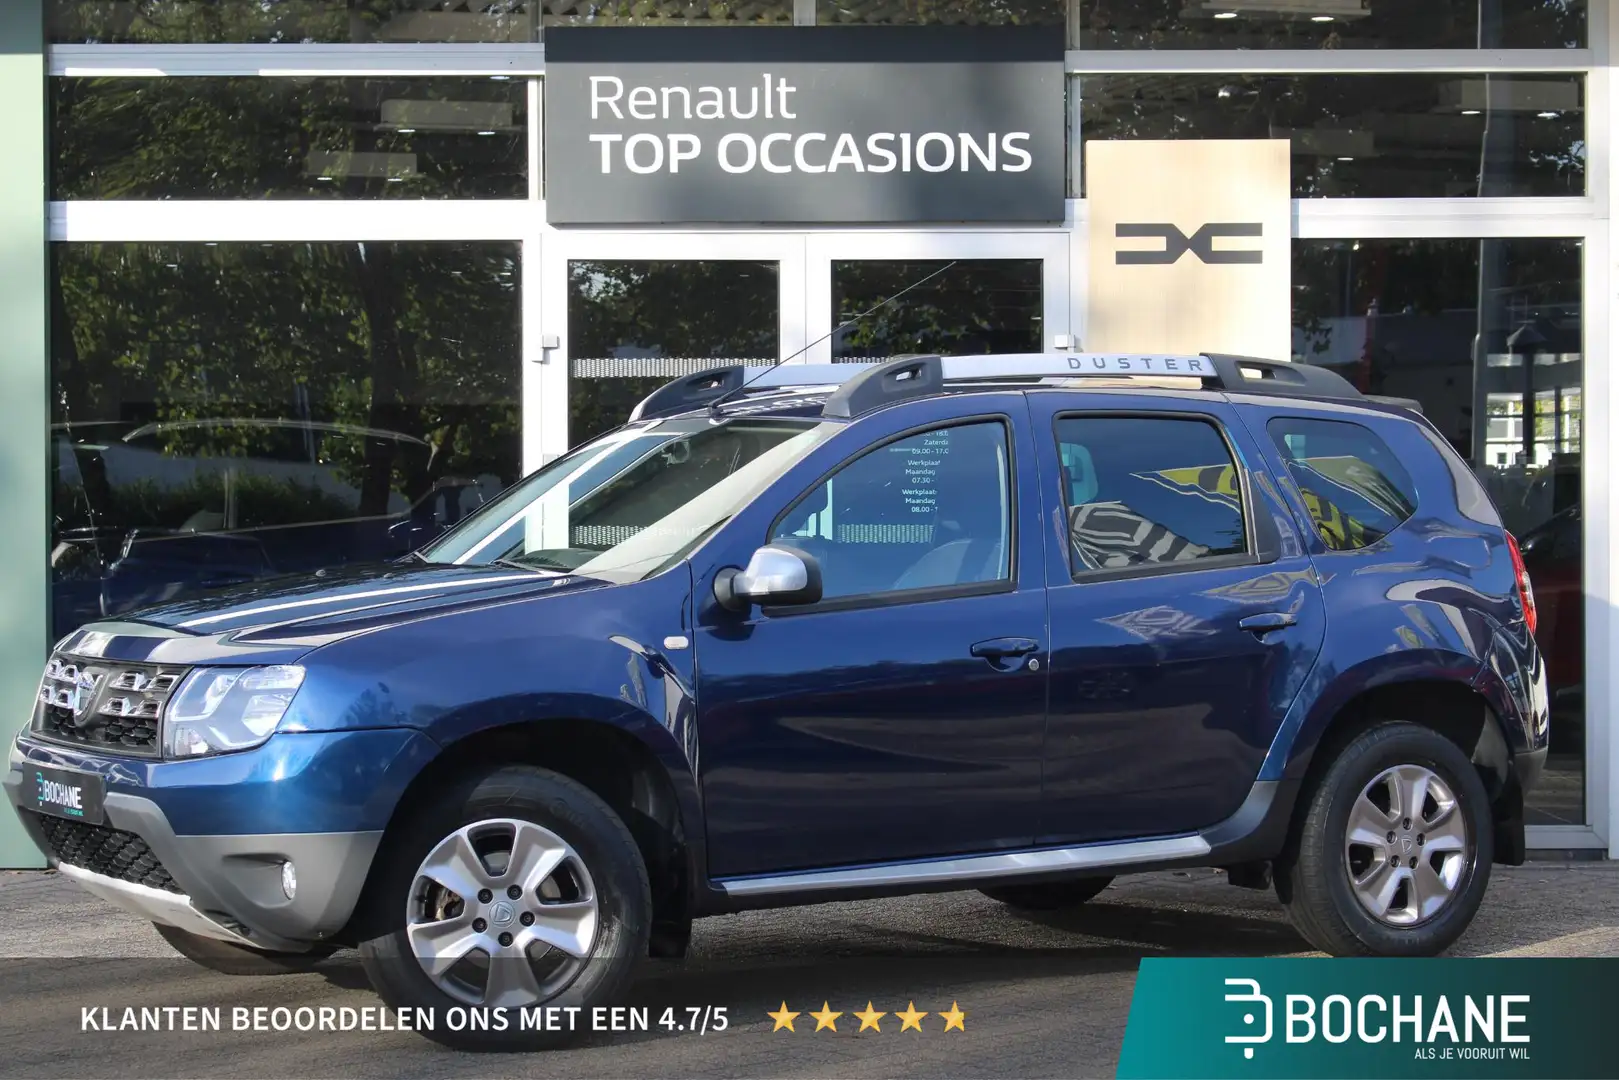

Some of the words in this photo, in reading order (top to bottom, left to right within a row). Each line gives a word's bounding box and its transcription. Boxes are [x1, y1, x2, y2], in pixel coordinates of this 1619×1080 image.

[589, 73, 797, 120] Renault
[589, 133, 702, 174] TOP
[717, 132, 1033, 175] OCCASIONS
[1067, 357, 1203, 371] DUSTER
[905, 468, 936, 476] Maandag
[901, 488, 938, 496] Werkplaat
[905, 497, 936, 505] Maandag
[44, 780, 83, 809] BOCHANE
